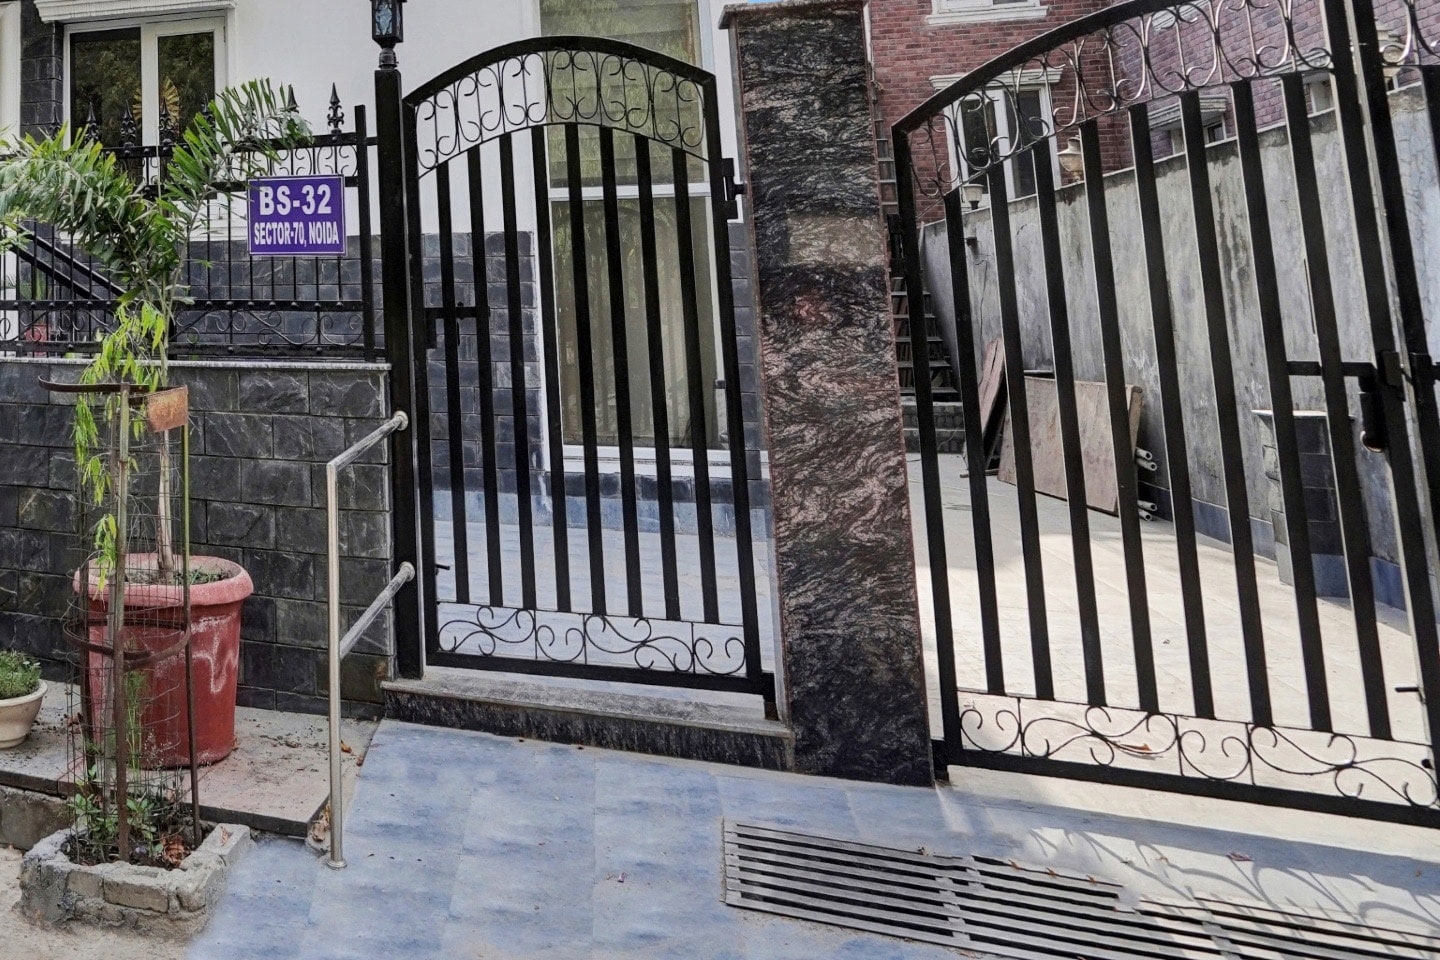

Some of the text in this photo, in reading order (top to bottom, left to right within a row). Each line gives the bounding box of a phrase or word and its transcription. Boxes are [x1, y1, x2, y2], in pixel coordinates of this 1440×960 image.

[259, 184, 332, 216] BS-32
[253, 221, 340, 247] SECTOR-70, NOIDA
